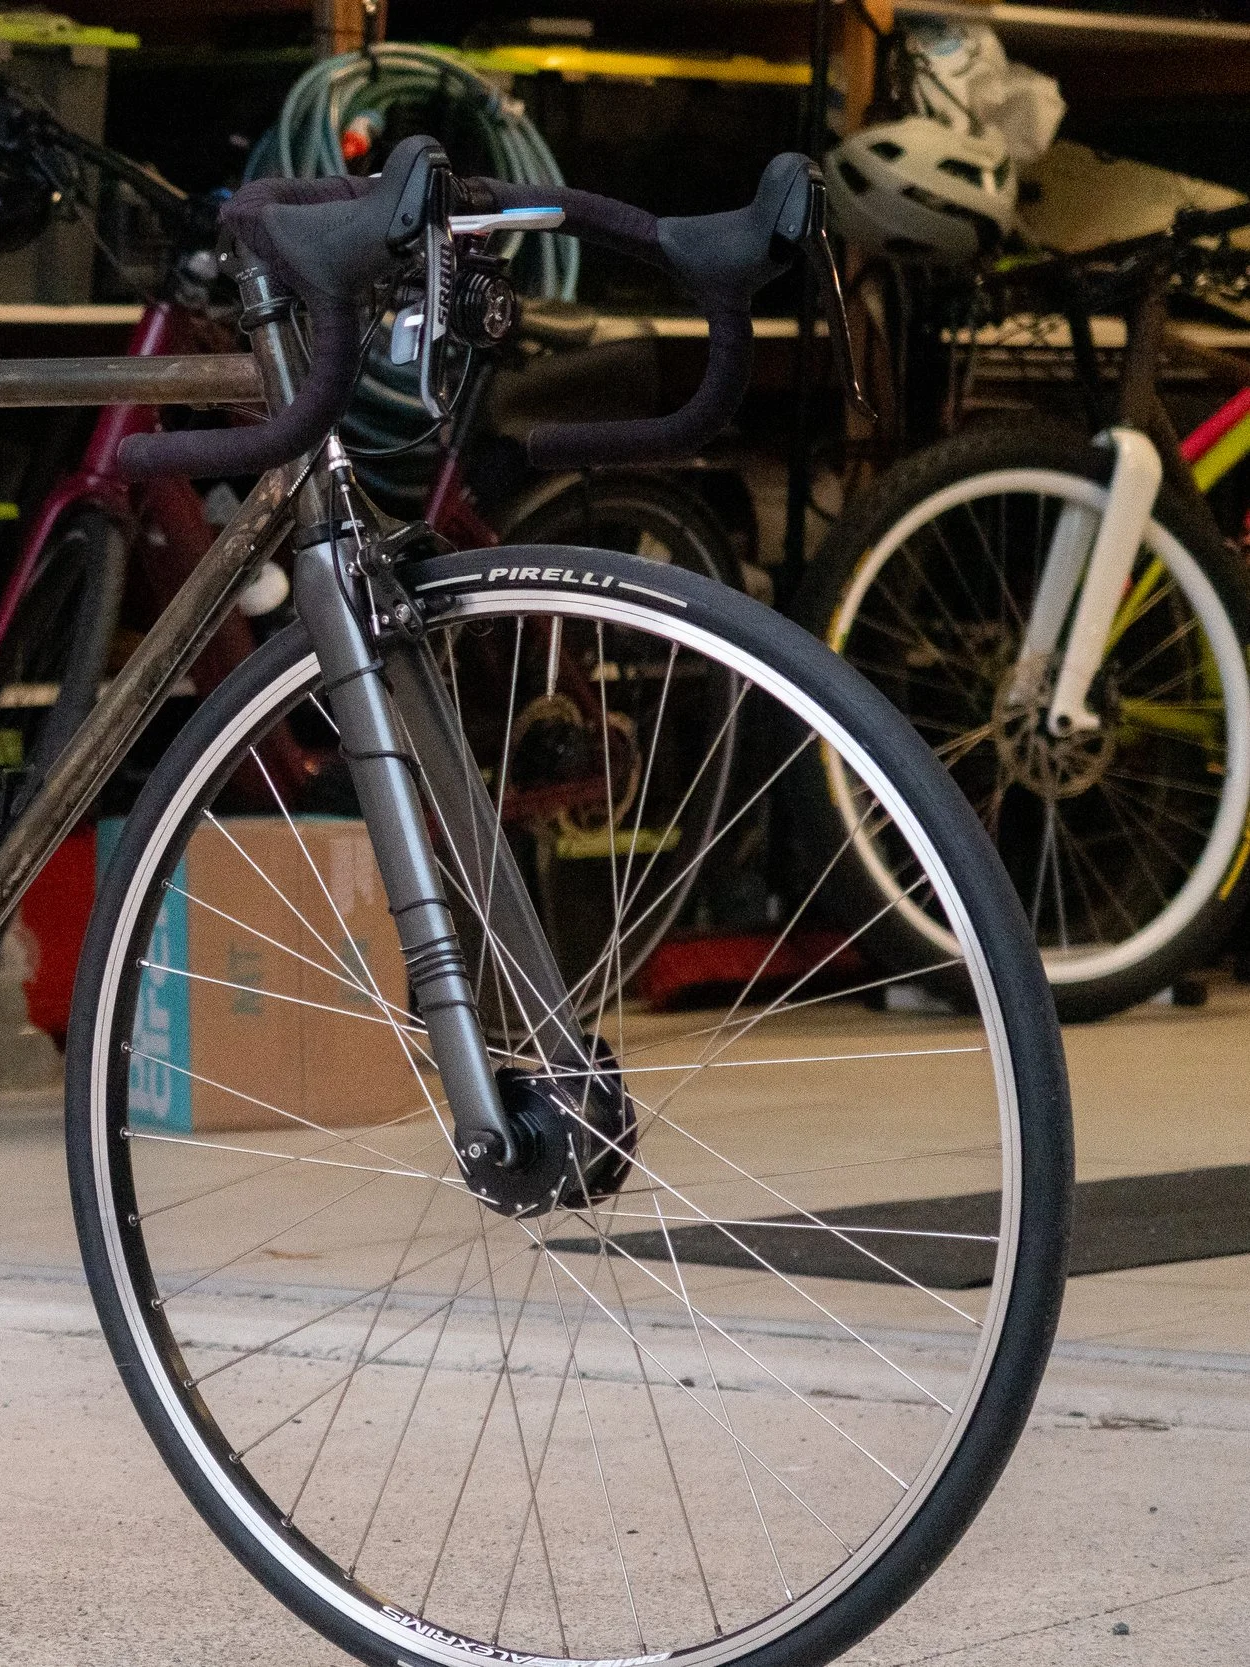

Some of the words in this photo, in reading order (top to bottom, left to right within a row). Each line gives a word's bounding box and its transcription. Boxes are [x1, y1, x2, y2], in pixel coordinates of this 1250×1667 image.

[438, 243, 452, 325] SRAM
[488, 567, 614, 587] PIRELLI
[380, 1604, 534, 1664] ALEXRIMS
